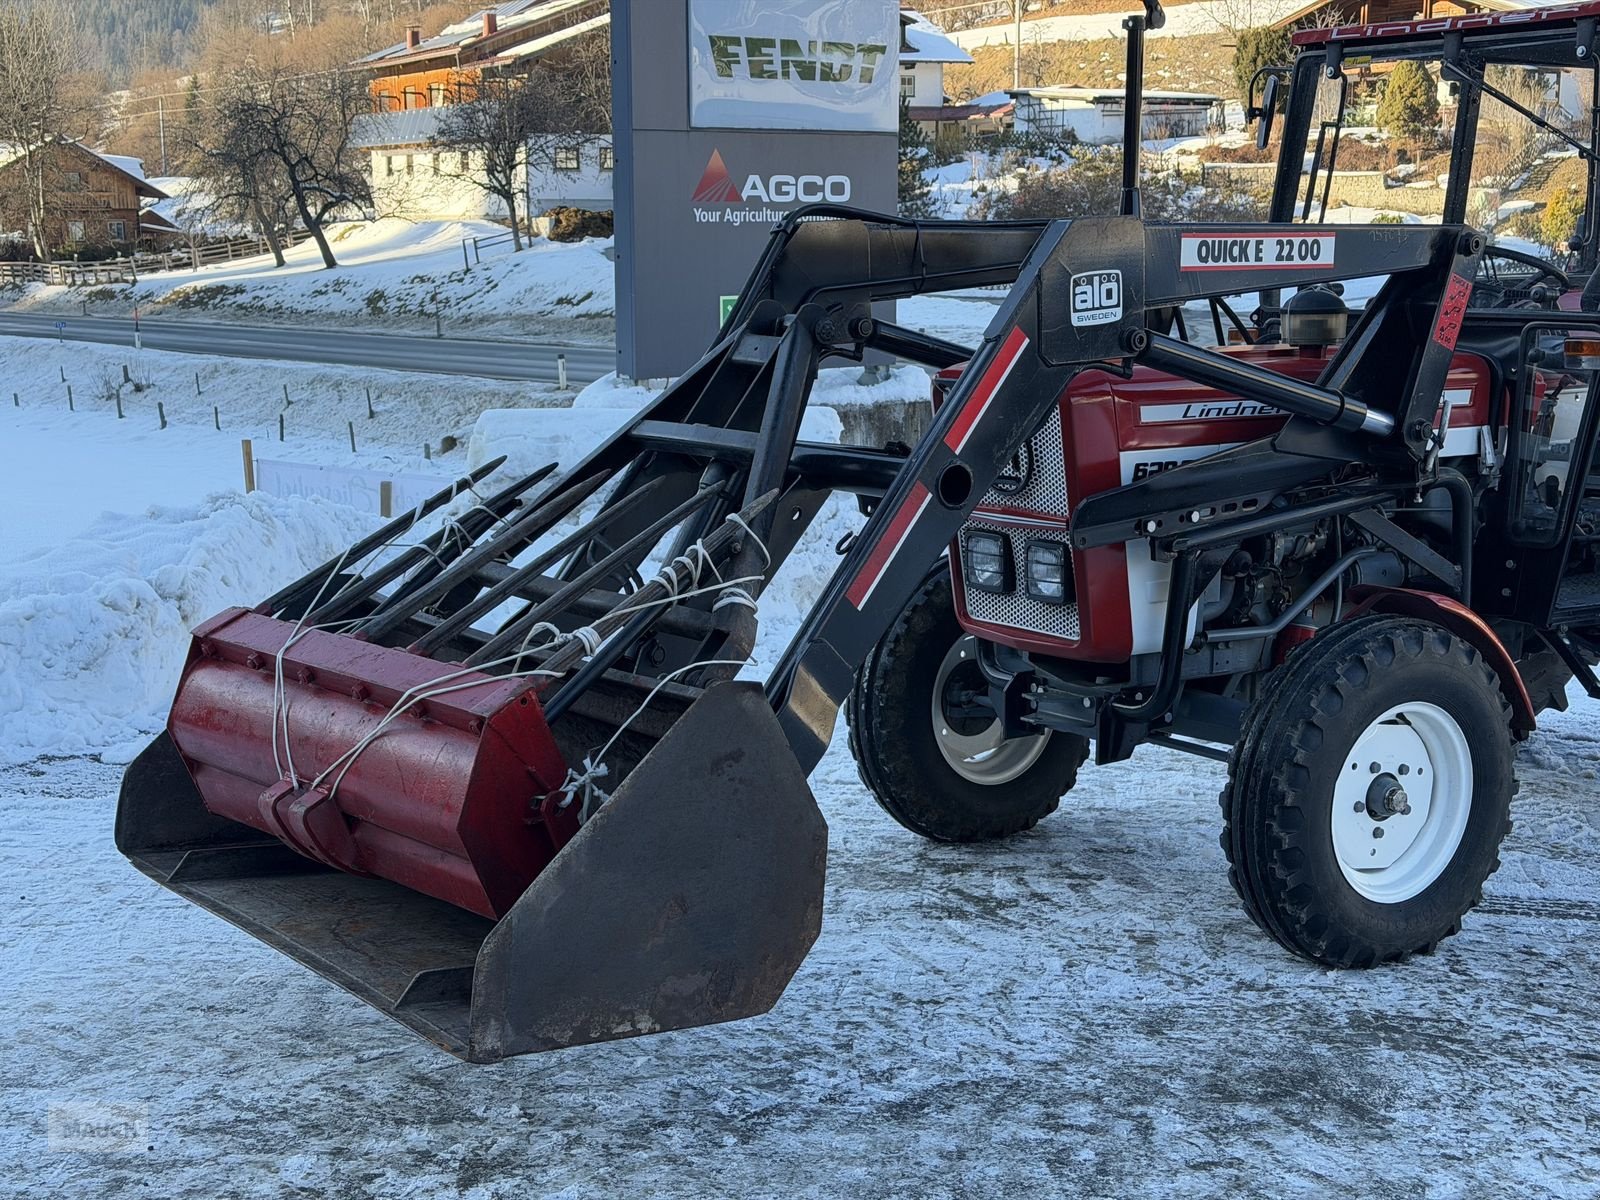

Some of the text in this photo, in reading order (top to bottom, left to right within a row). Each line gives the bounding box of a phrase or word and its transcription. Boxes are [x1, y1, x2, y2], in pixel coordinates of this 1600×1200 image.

[1330, 7, 1579, 39] Lindner
[708, 35, 887, 84] FENDT
[741, 174, 851, 203] AGCO
[693, 207, 721, 222] Your
[1197, 239, 1321, 264] QUICK E 2200
[1077, 311, 1117, 322] SWEDEN
